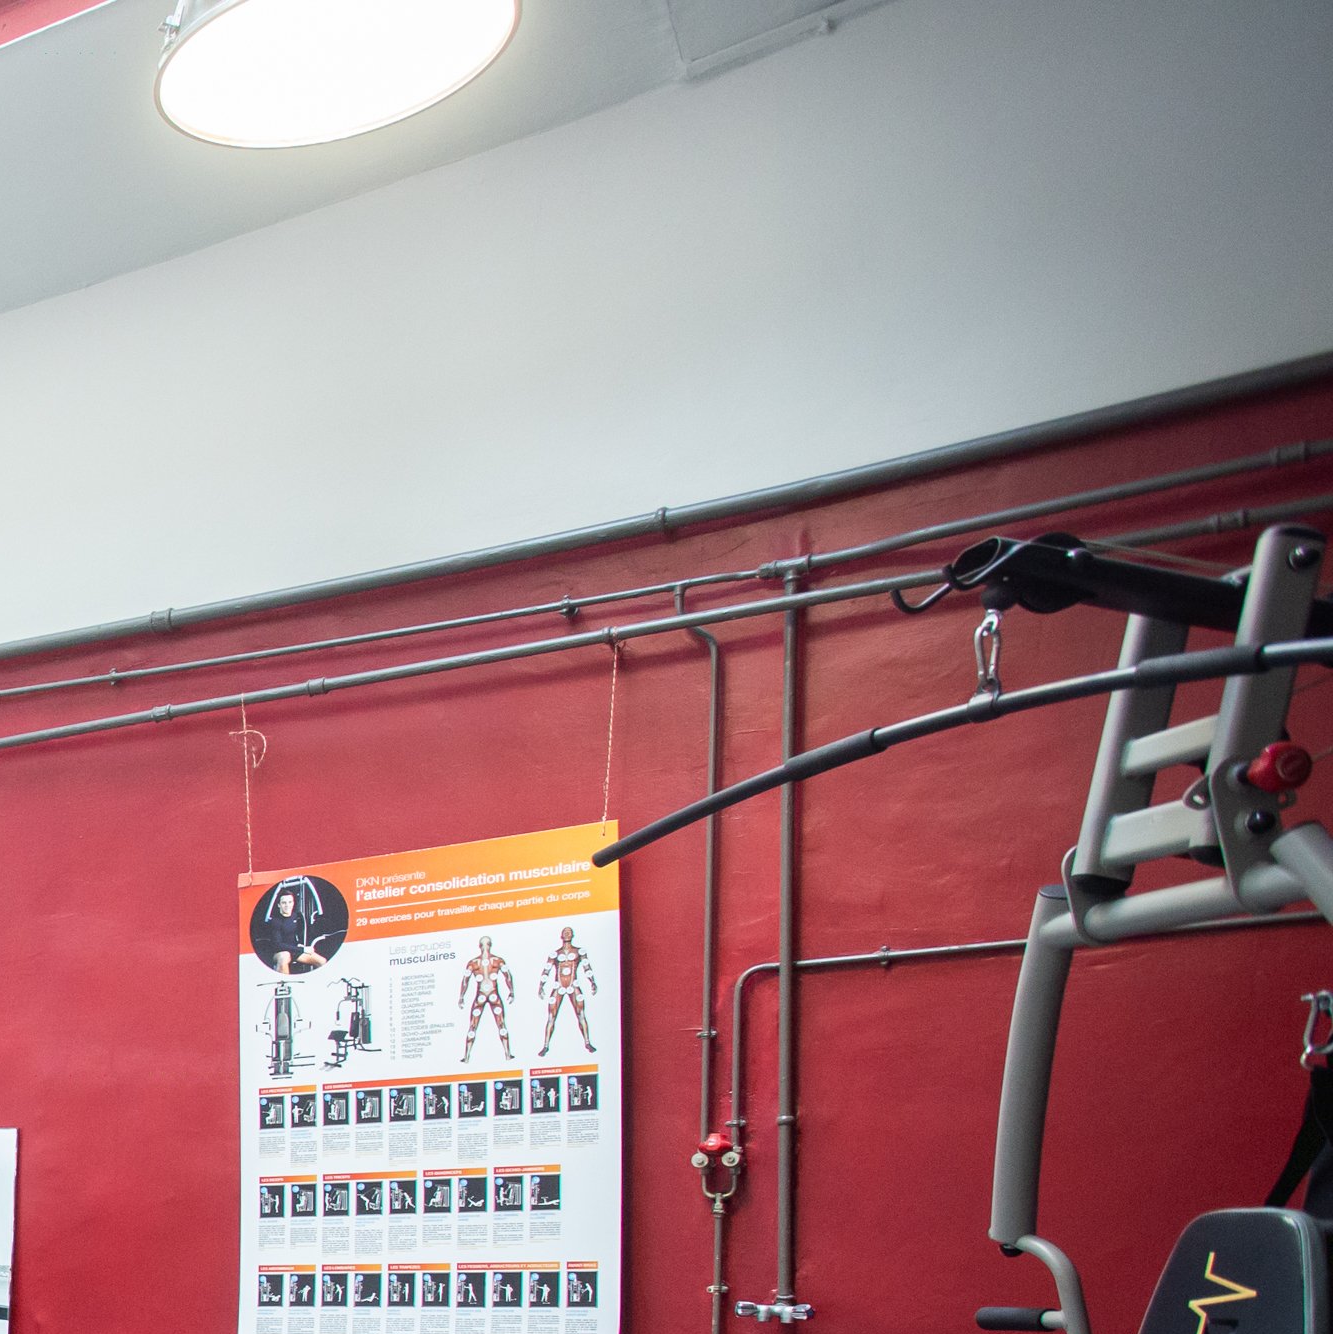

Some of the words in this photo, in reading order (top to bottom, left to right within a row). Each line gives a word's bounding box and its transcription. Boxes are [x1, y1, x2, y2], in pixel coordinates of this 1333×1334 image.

[356, 876, 379, 888] DKN
[382, 870, 426, 886] présente
[356, 886, 406, 902] l'atelier
[409, 870, 505, 894] consolidation
[509, 860, 591, 882] musculaire
[356, 917, 368, 927] 29
[370, 912, 412, 925] exercices
[414, 910, 435, 921] pour
[437, 904, 476, 917] travailler
[478, 899, 514, 912] chaque
[516, 896, 544, 908] partie
[546, 893, 559, 903] du
[561, 889, 591, 902] corps
[389, 945, 407, 955] Les
[410, 941, 452, 954] groupes
[389, 951, 456, 966] musculaires
